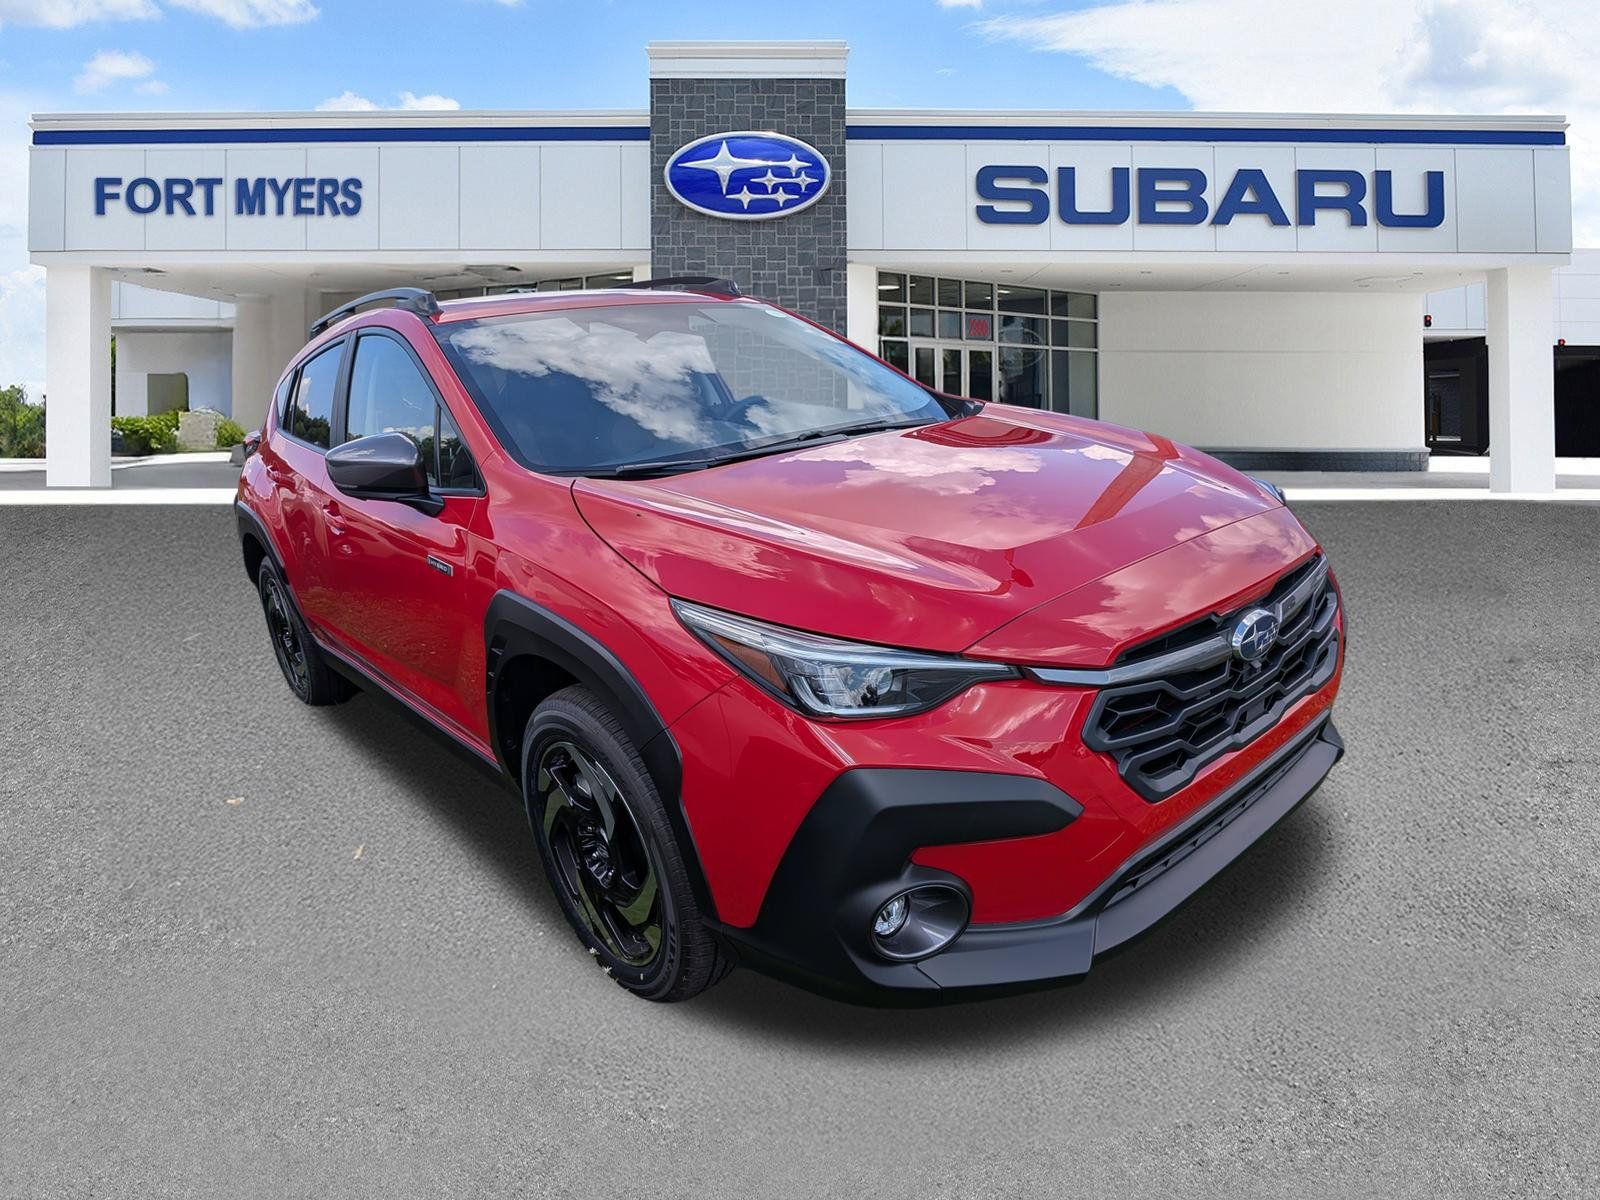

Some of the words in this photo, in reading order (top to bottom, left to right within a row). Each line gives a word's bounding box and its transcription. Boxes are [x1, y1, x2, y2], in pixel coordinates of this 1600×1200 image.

[94, 177, 223, 217] FORT
[235, 177, 363, 217] MYERS
[976, 165, 1446, 228] SUBARU
